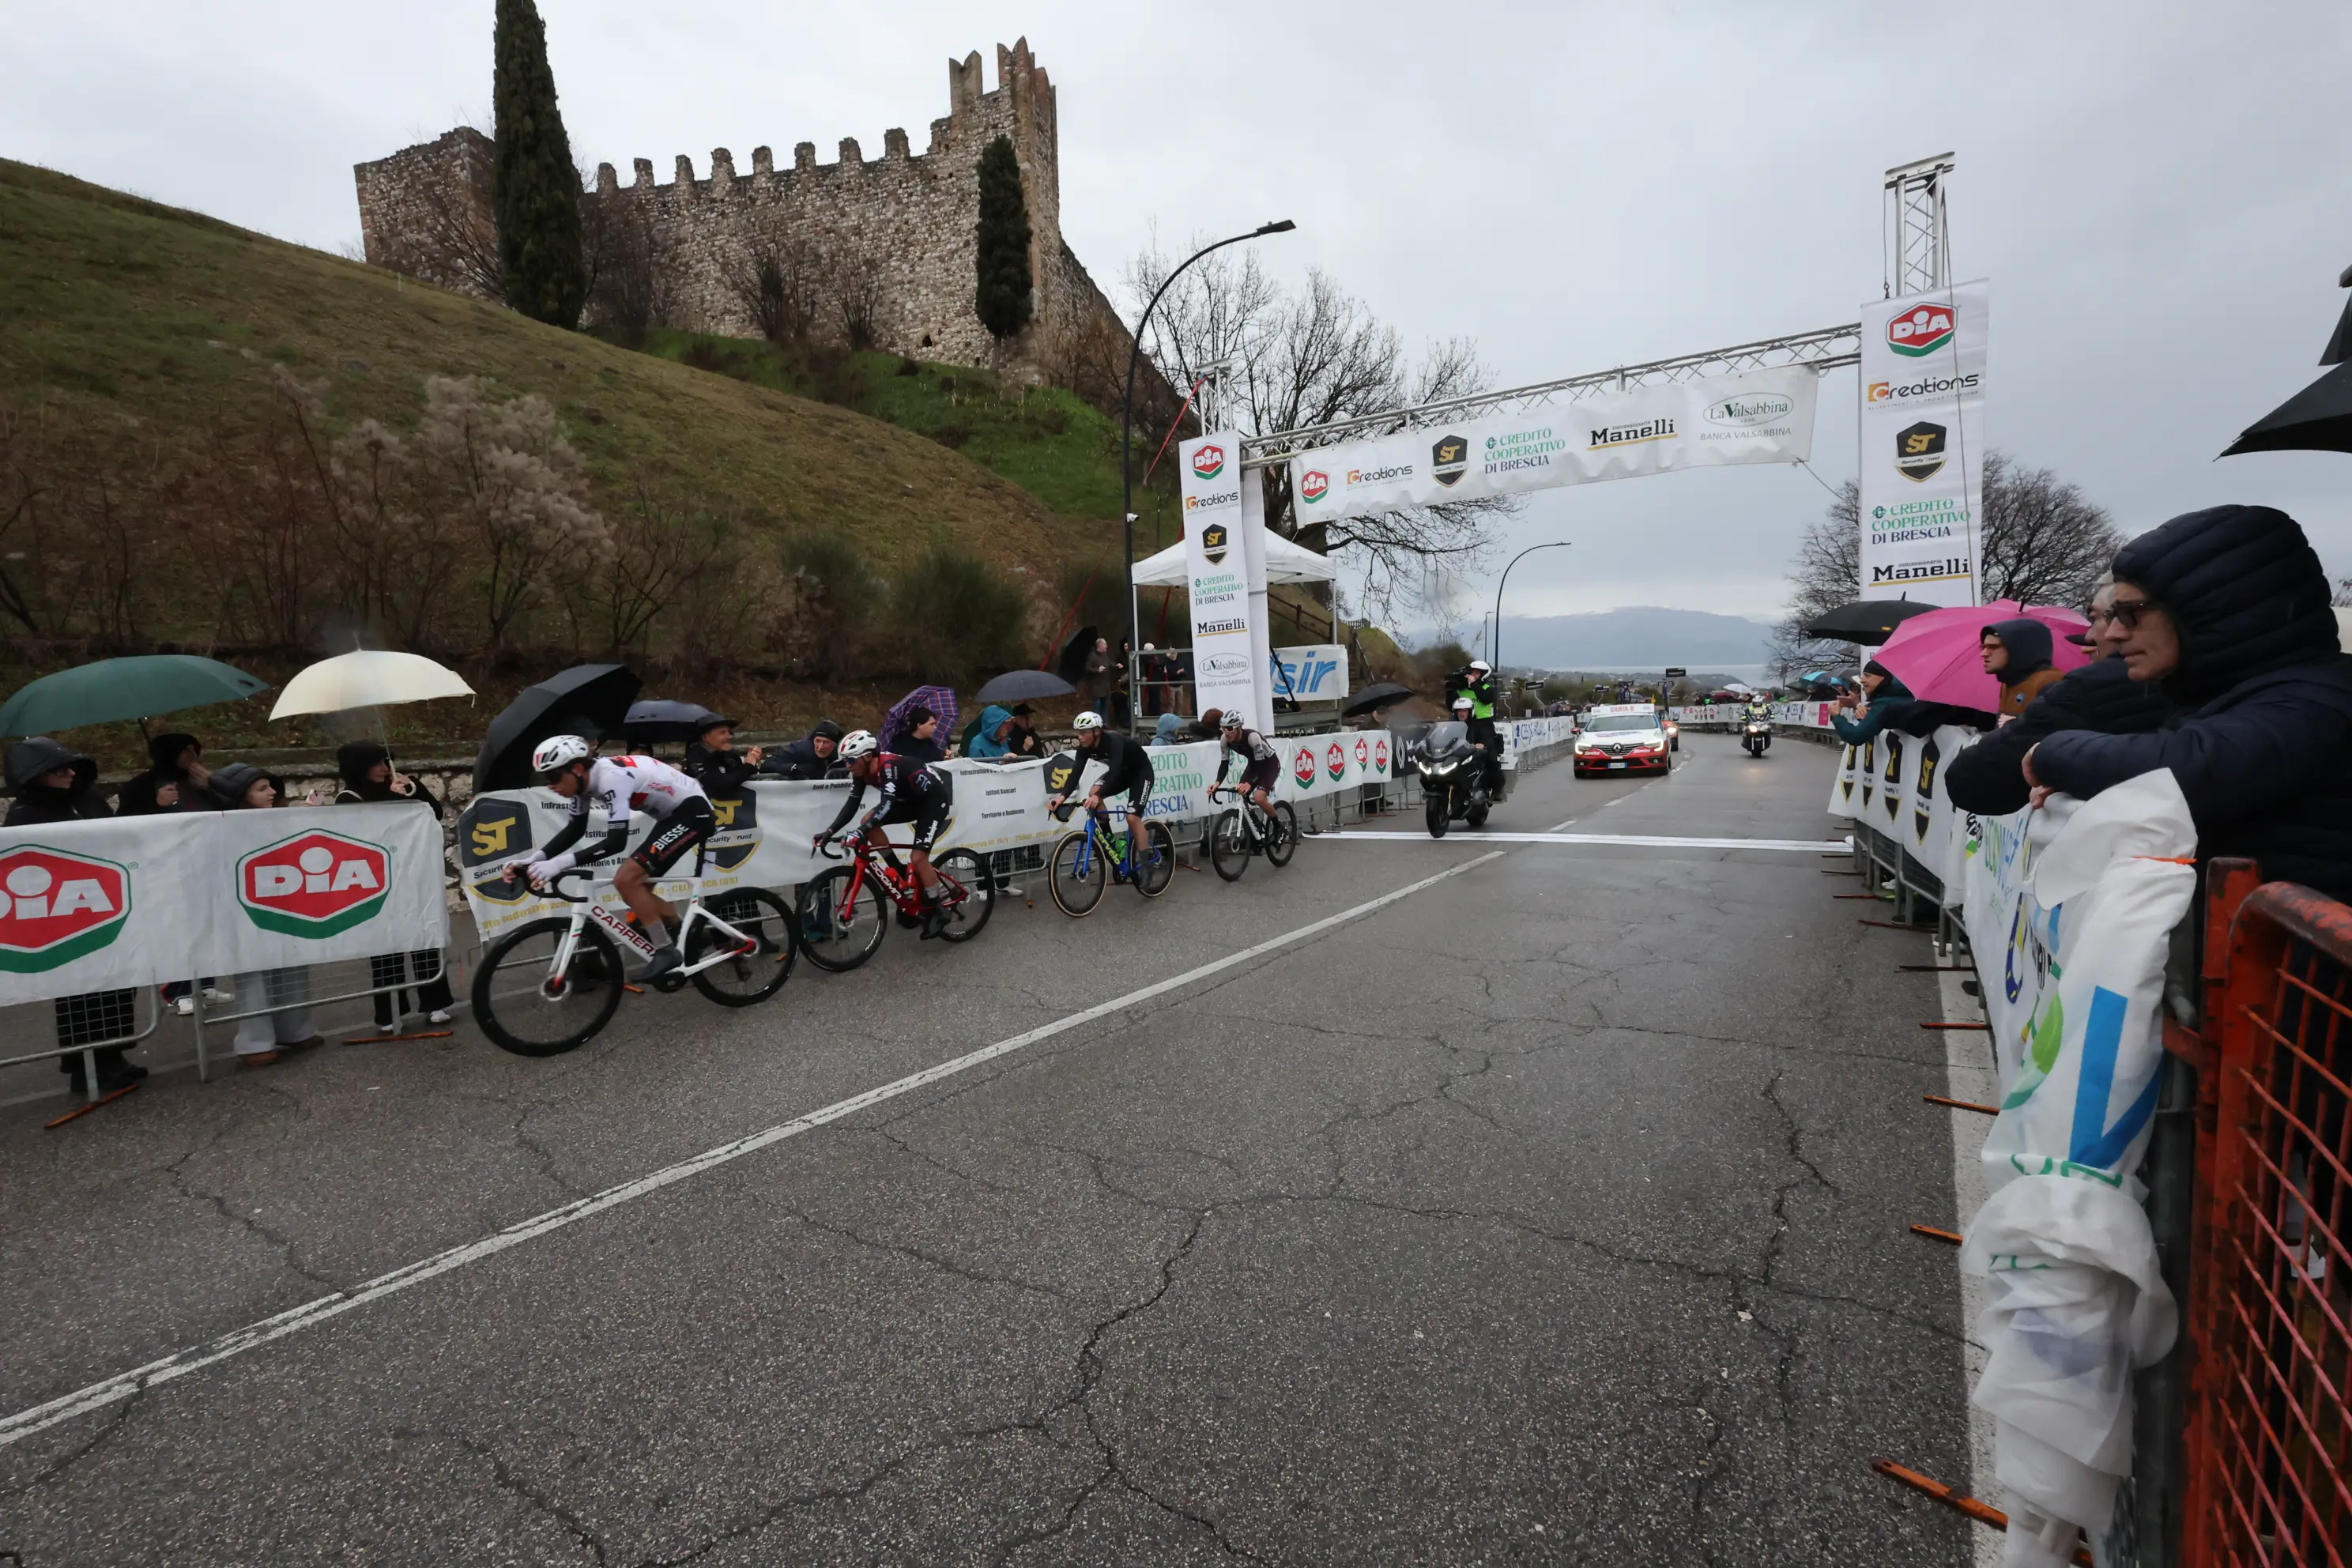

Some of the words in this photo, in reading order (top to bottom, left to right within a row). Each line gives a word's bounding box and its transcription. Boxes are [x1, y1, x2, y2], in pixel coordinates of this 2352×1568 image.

[1871, 374, 1979, 401] Creations
[1500, 428, 1551, 447] CREDITO
[1591, 419, 1675, 445] Manelli
[1701, 431, 1732, 441] BANCA
[1735, 428, 1792, 439] VALSABBINA
[1484, 439, 1566, 462] COOPERATIVO
[1905, 433, 1936, 454] ST
[1438, 445, 1461, 462] ST
[1485, 463, 1497, 474] DI
[1501, 454, 1550, 472] BRESCIA
[1347, 465, 1412, 484] Creations
[1186, 492, 1238, 511] Creations
[1890, 498, 1954, 516] CREDITO
[1871, 510, 1971, 532] COOPERATIVO
[1207, 532, 1222, 545] ST
[1872, 533, 1886, 545] DI
[1891, 526, 1951, 543] BRESCIA
[1872, 558, 1969, 582] Manelli
[1195, 582, 1244, 597] COOPERATIVO
[1203, 574, 1234, 586] CREDITO
[1196, 597, 1203, 606] DI
[1205, 593, 1234, 605] BRESCIA
[1197, 618, 1246, 634] Manelli
[1200, 680, 1217, 688] BANCA
[1218, 678, 1252, 687] VALSABBINA
[471, 816, 516, 857] ST
[654, 824, 689, 850] BIESSE
[706, 835, 730, 844] ecurity
[474, 865, 504, 880] Securit
[870, 862, 903, 900] DOGMA
[591, 905, 656, 958] CARRER
